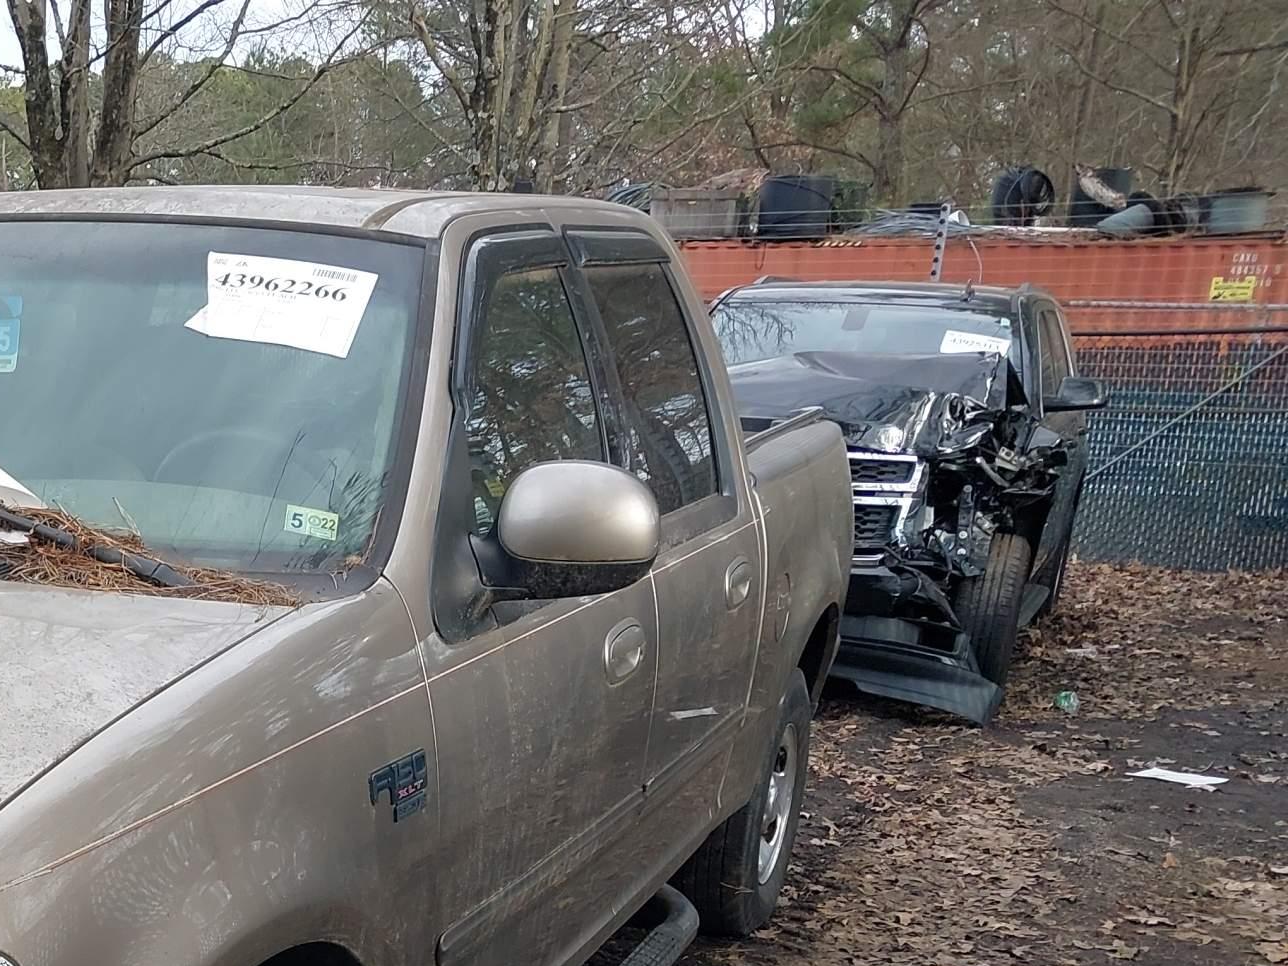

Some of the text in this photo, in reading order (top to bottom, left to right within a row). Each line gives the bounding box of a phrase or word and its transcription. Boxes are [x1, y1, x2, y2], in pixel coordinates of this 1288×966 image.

[215, 272, 350, 302] 43962266
[290, 511, 336, 531] 5 22
[397, 779, 424, 800] XLT
